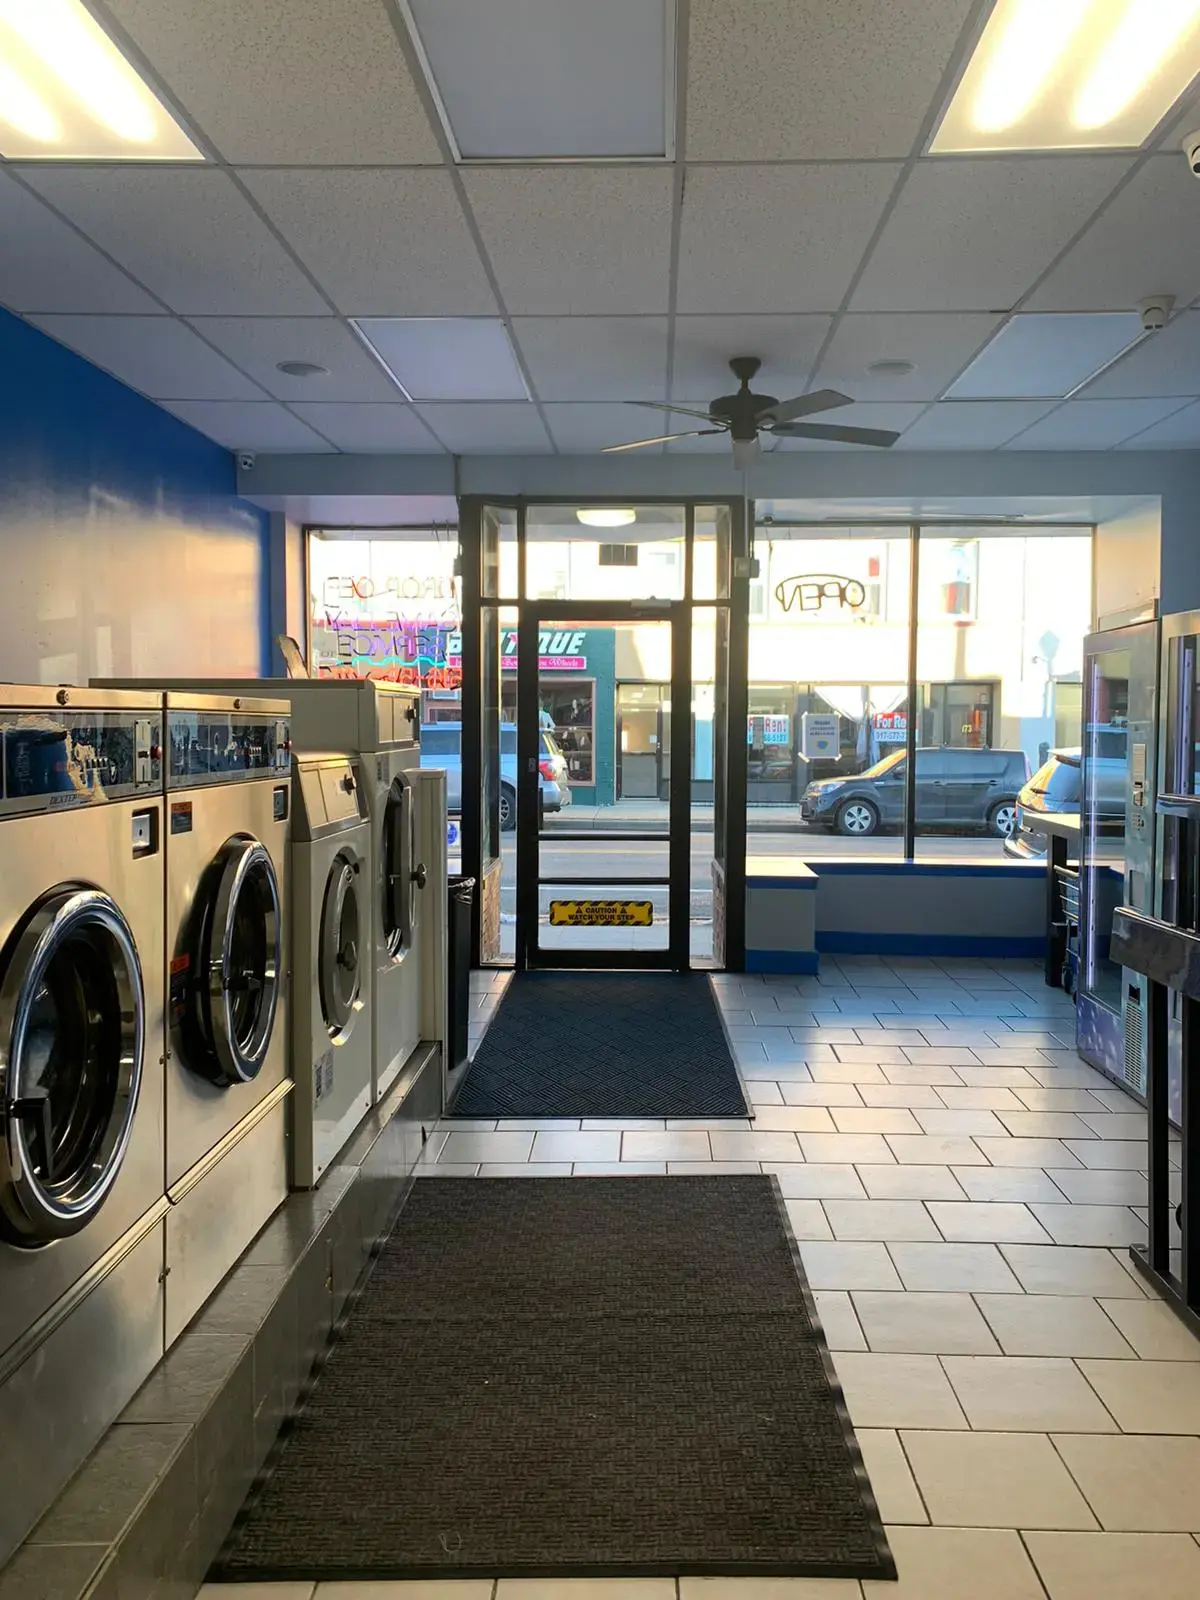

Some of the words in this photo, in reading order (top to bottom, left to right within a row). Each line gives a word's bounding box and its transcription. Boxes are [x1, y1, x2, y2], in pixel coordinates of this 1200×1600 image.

[765, 717, 786, 733] Rent
[876, 714, 892, 728] For
[585, 906, 618, 914] CAUTION
